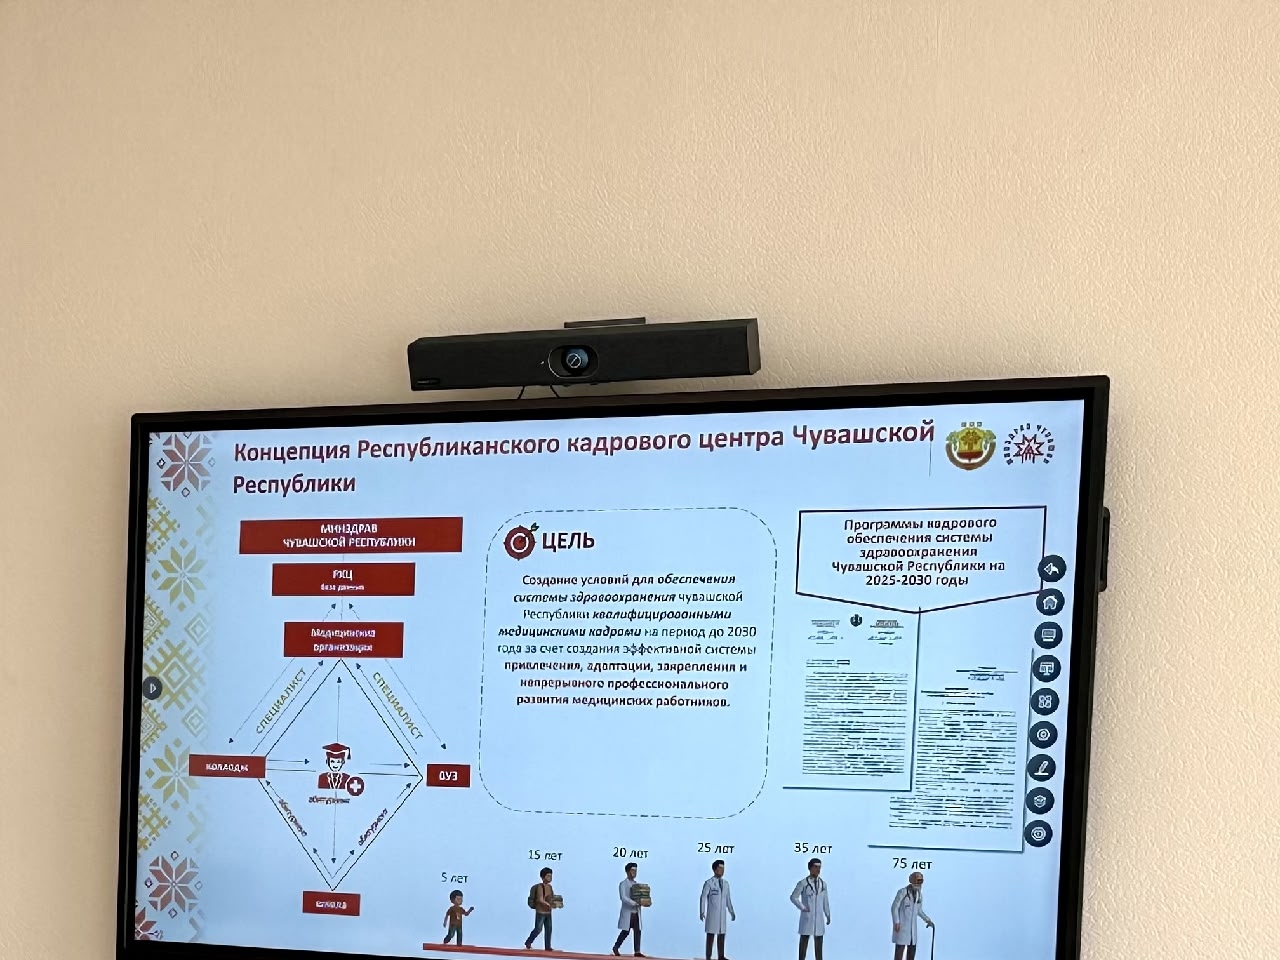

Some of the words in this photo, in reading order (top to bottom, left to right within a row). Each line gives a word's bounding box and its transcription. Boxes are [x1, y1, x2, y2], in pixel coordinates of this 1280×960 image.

[234, 442, 350, 464] Концепция
[358, 436, 560, 462] Республиканского
[568, 432, 691, 457] кадрового
[699, 430, 784, 452] центра
[792, 419, 935, 450] Чувашской
[233, 473, 356, 498] Республики
[320, 523, 378, 536] МИНЗДРАВ
[844, 519, 924, 532] Программы
[927, 518, 997, 532] кадрового
[282, 536, 346, 548] ЧУВАШСКОЙ
[348, 537, 416, 548] РЕСПУБЛИКИ
[542, 531, 596, 553] ЦЕЛЬ
[846, 533, 932, 545] обеспечения
[935, 533, 993, 542] системы
[859, 548, 978, 560] здравоохранения
[832, 560, 904, 574] Чувашской
[907, 561, 986, 574] Республики
[989, 562, 1006, 571] на
[522, 575, 578, 586] Создание
[580, 574, 629, 586] условий
[631, 576, 654, 586] для
[657, 574, 736, 584] обеспечения
[865, 574, 932, 586] 2025-2030
[936, 576, 969, 588] годы
[513, 594, 568, 603] системы
[570, 594, 676, 605] здравоохранения
[678, 591, 743, 603] чувашской
[523, 608, 590, 621] Республики
[592, 610, 732, 622] квалифицированными
[498, 627, 586, 638] медицинскими
[588, 627, 642, 638] кадрами
[644, 628, 659, 637] на
[661, 627, 706, 639] период
[708, 627, 724, 638] до
[727, 626, 757, 637] 2030
[498, 644, 522, 655] года
[524, 645, 537, 654] за
[540, 644, 564, 654] счет
[566, 644, 620, 655] создания
[622, 643, 702, 657] эффективной
[705, 645, 756, 655] системы
[504, 662, 583, 672] привлечения,
[587, 662, 654, 673] адаптации,
[656, 663, 736, 675] закрепления
[739, 664, 747, 672] и
[520, 679, 604, 690] непрерывного
[607, 679, 729, 691] профессионального
[256, 668, 308, 736] СПЕЦИАЛИСТ
[372, 671, 424, 741] СПЕЦИАЛИСТ
[516, 696, 569, 706] развития
[572, 696, 653, 707] медицинских
[656, 696, 731, 708] работников.
[612, 846, 628, 858] 20
[630, 848, 649, 859] лет
[697, 842, 712, 854] 25
[714, 844, 736, 854] лет
[794, 842, 810, 854] 35
[812, 844, 833, 854] лет
[528, 850, 542, 860] 15
[544, 850, 564, 862] лет
[892, 858, 908, 870] 75
[910, 859, 932, 870] лет
[440, 872, 448, 882] 5
[450, 873, 470, 884] лет
